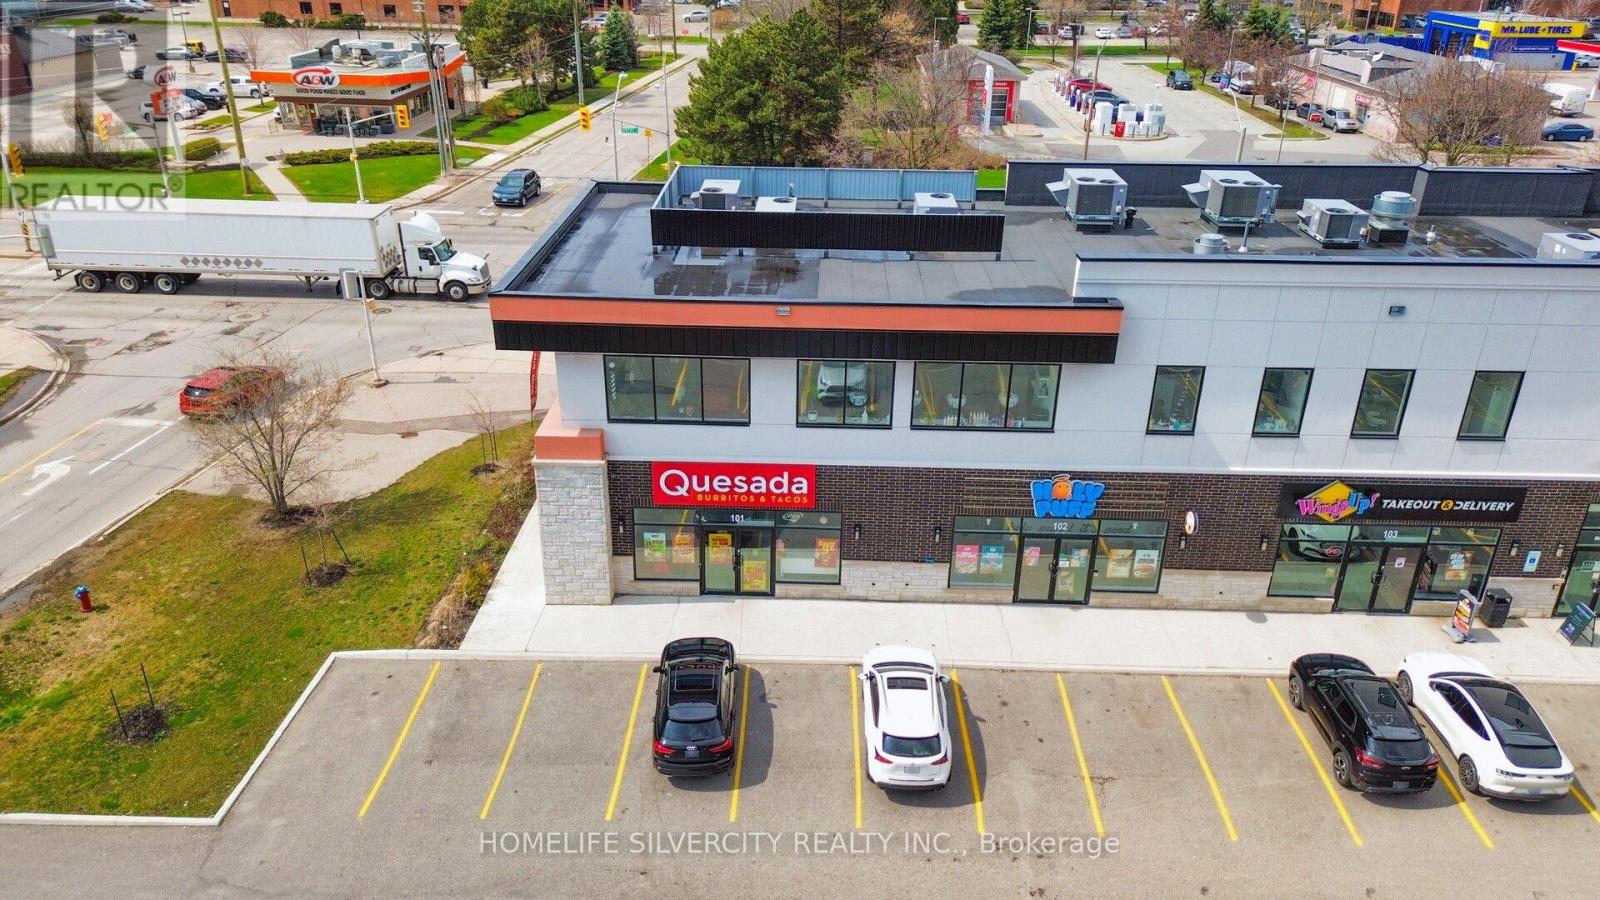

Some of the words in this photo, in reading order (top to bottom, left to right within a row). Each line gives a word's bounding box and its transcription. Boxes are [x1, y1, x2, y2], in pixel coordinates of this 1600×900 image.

[1501, 25, 1518, 34] MR.
[1519, 25, 1541, 34] LUBE
[1547, 25, 1573, 34] TIRES
[299, 75, 336, 86] A&W
[659, 469, 808, 497] Quesada
[697, 493, 754, 503] BURRITOS
[759, 495, 766, 503] &
[771, 495, 808, 504] TACOS
[1382, 499, 1441, 510] TAKEOUT
[1453, 500, 1515, 512] DELIVERY
[730, 514, 744, 523] 101
[1052, 522, 1068, 530] 102
[1383, 530, 1398, 538] 103
